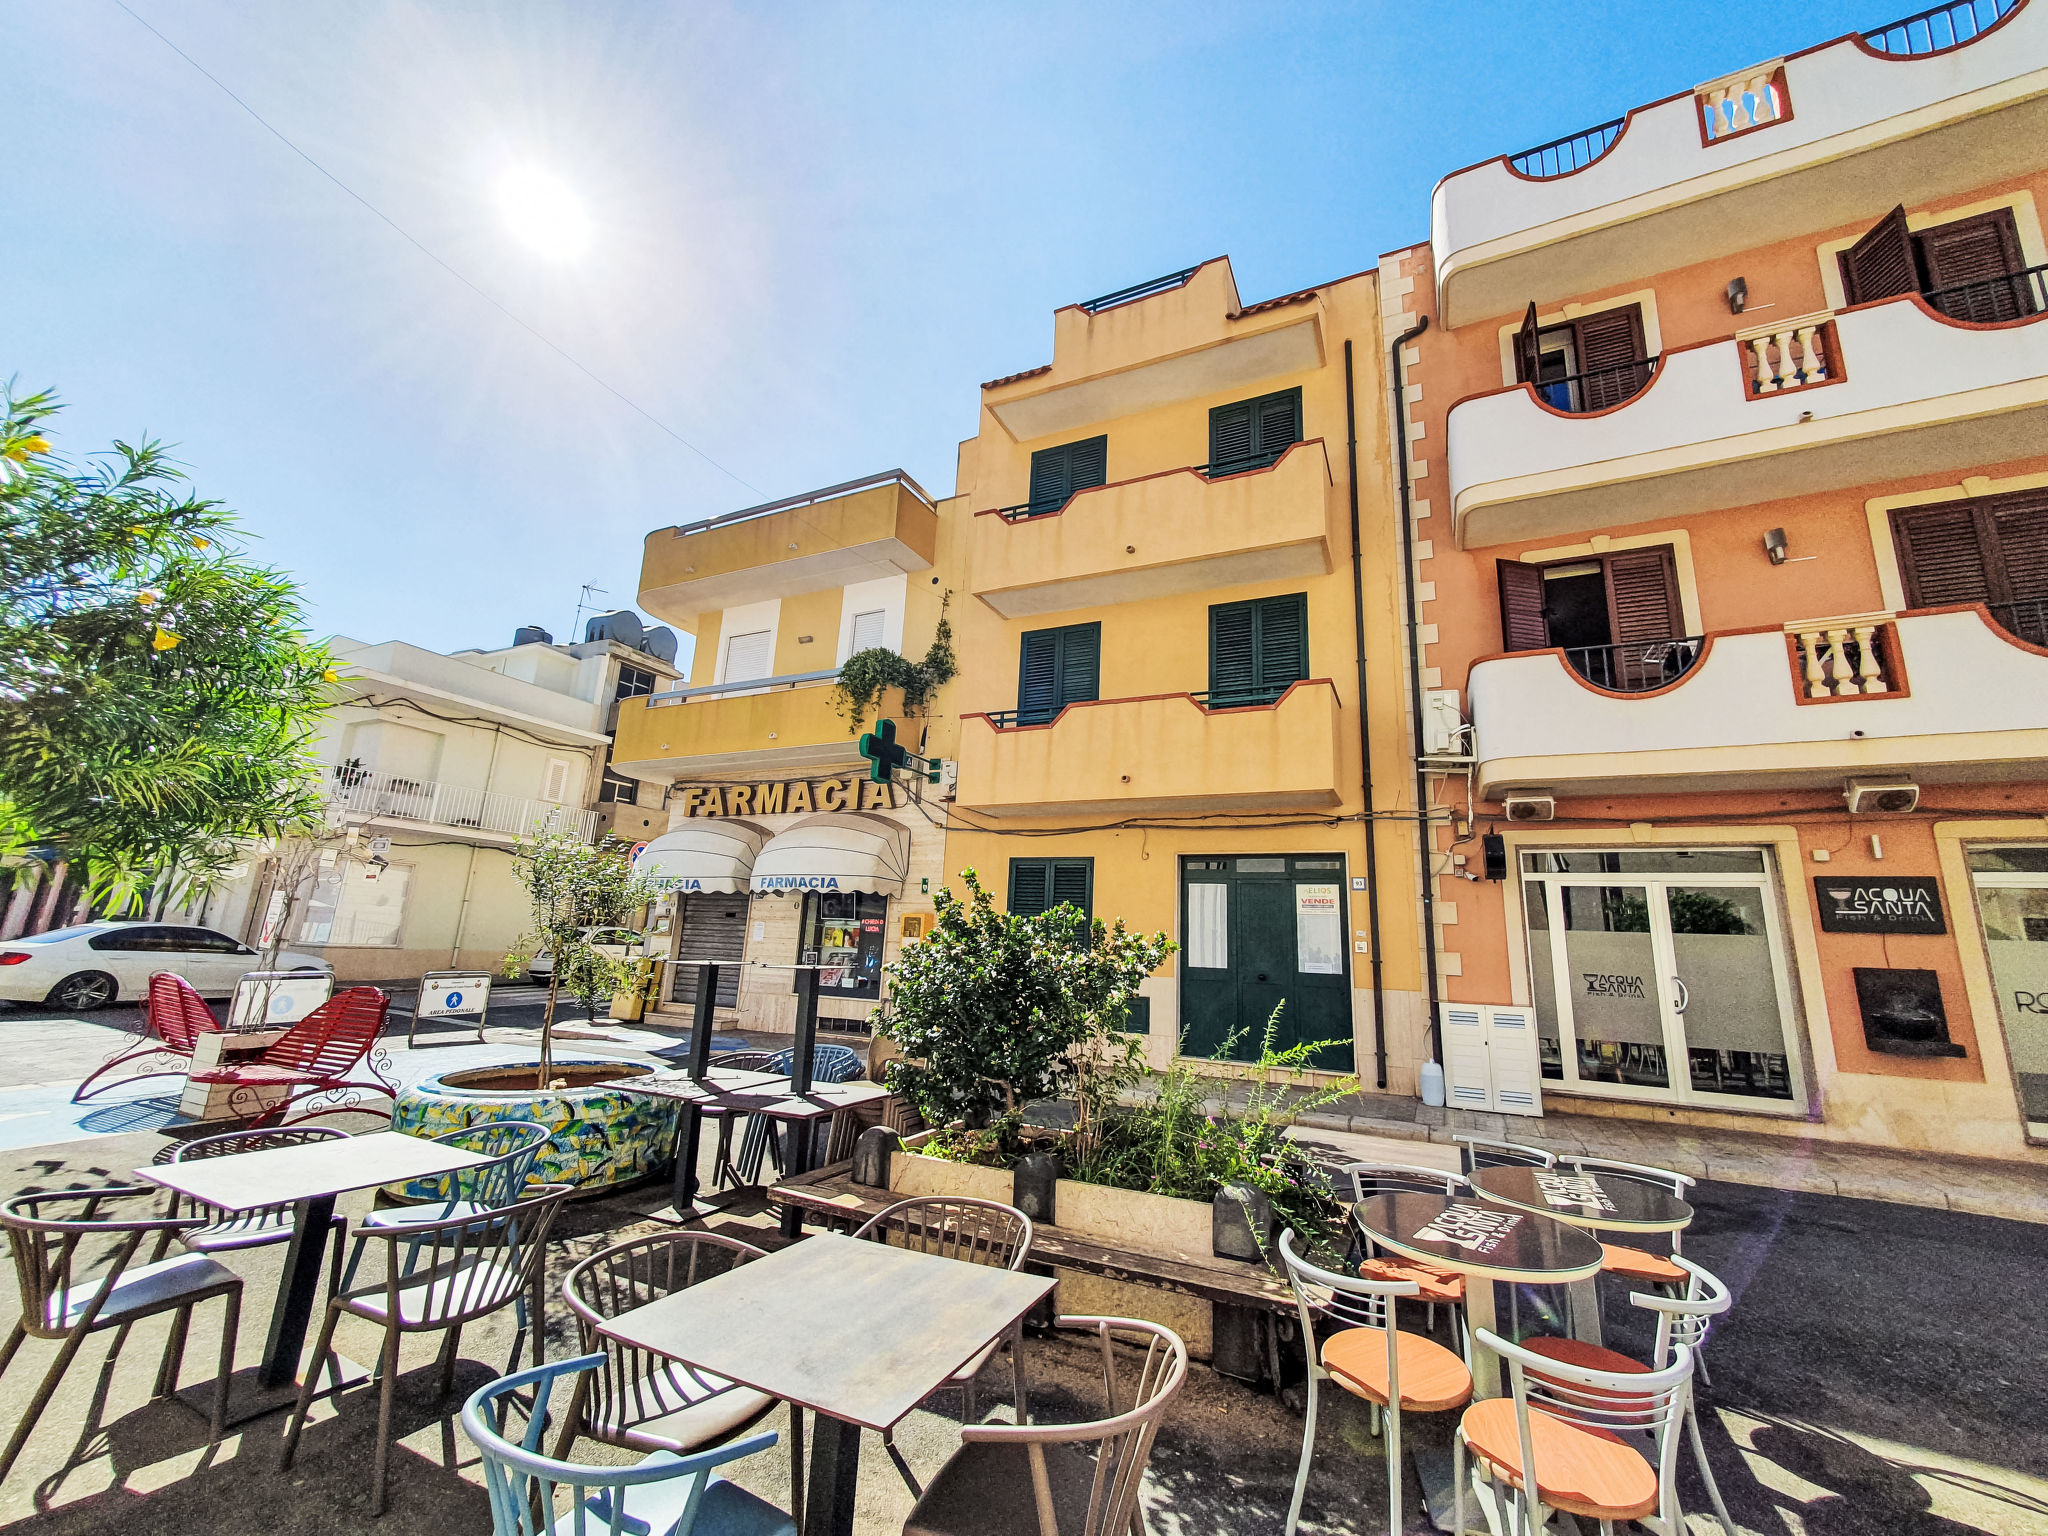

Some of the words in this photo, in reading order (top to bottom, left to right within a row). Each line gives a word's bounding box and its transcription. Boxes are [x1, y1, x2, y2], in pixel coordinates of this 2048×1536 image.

[684, 778, 893, 817] FARMACIA
[760, 877, 839, 889] FARMACIA
[1854, 888, 1931, 902] ACQUA
[1836, 901, 1936, 922] SANTA
[1599, 974, 1644, 985] ACQUA
[1592, 984, 1646, 998] SANTA
[1427, 1203, 1482, 1235] ACQUA
[1455, 1209, 1524, 1250] SANTA
[1477, 1238, 1501, 1255] Fish
